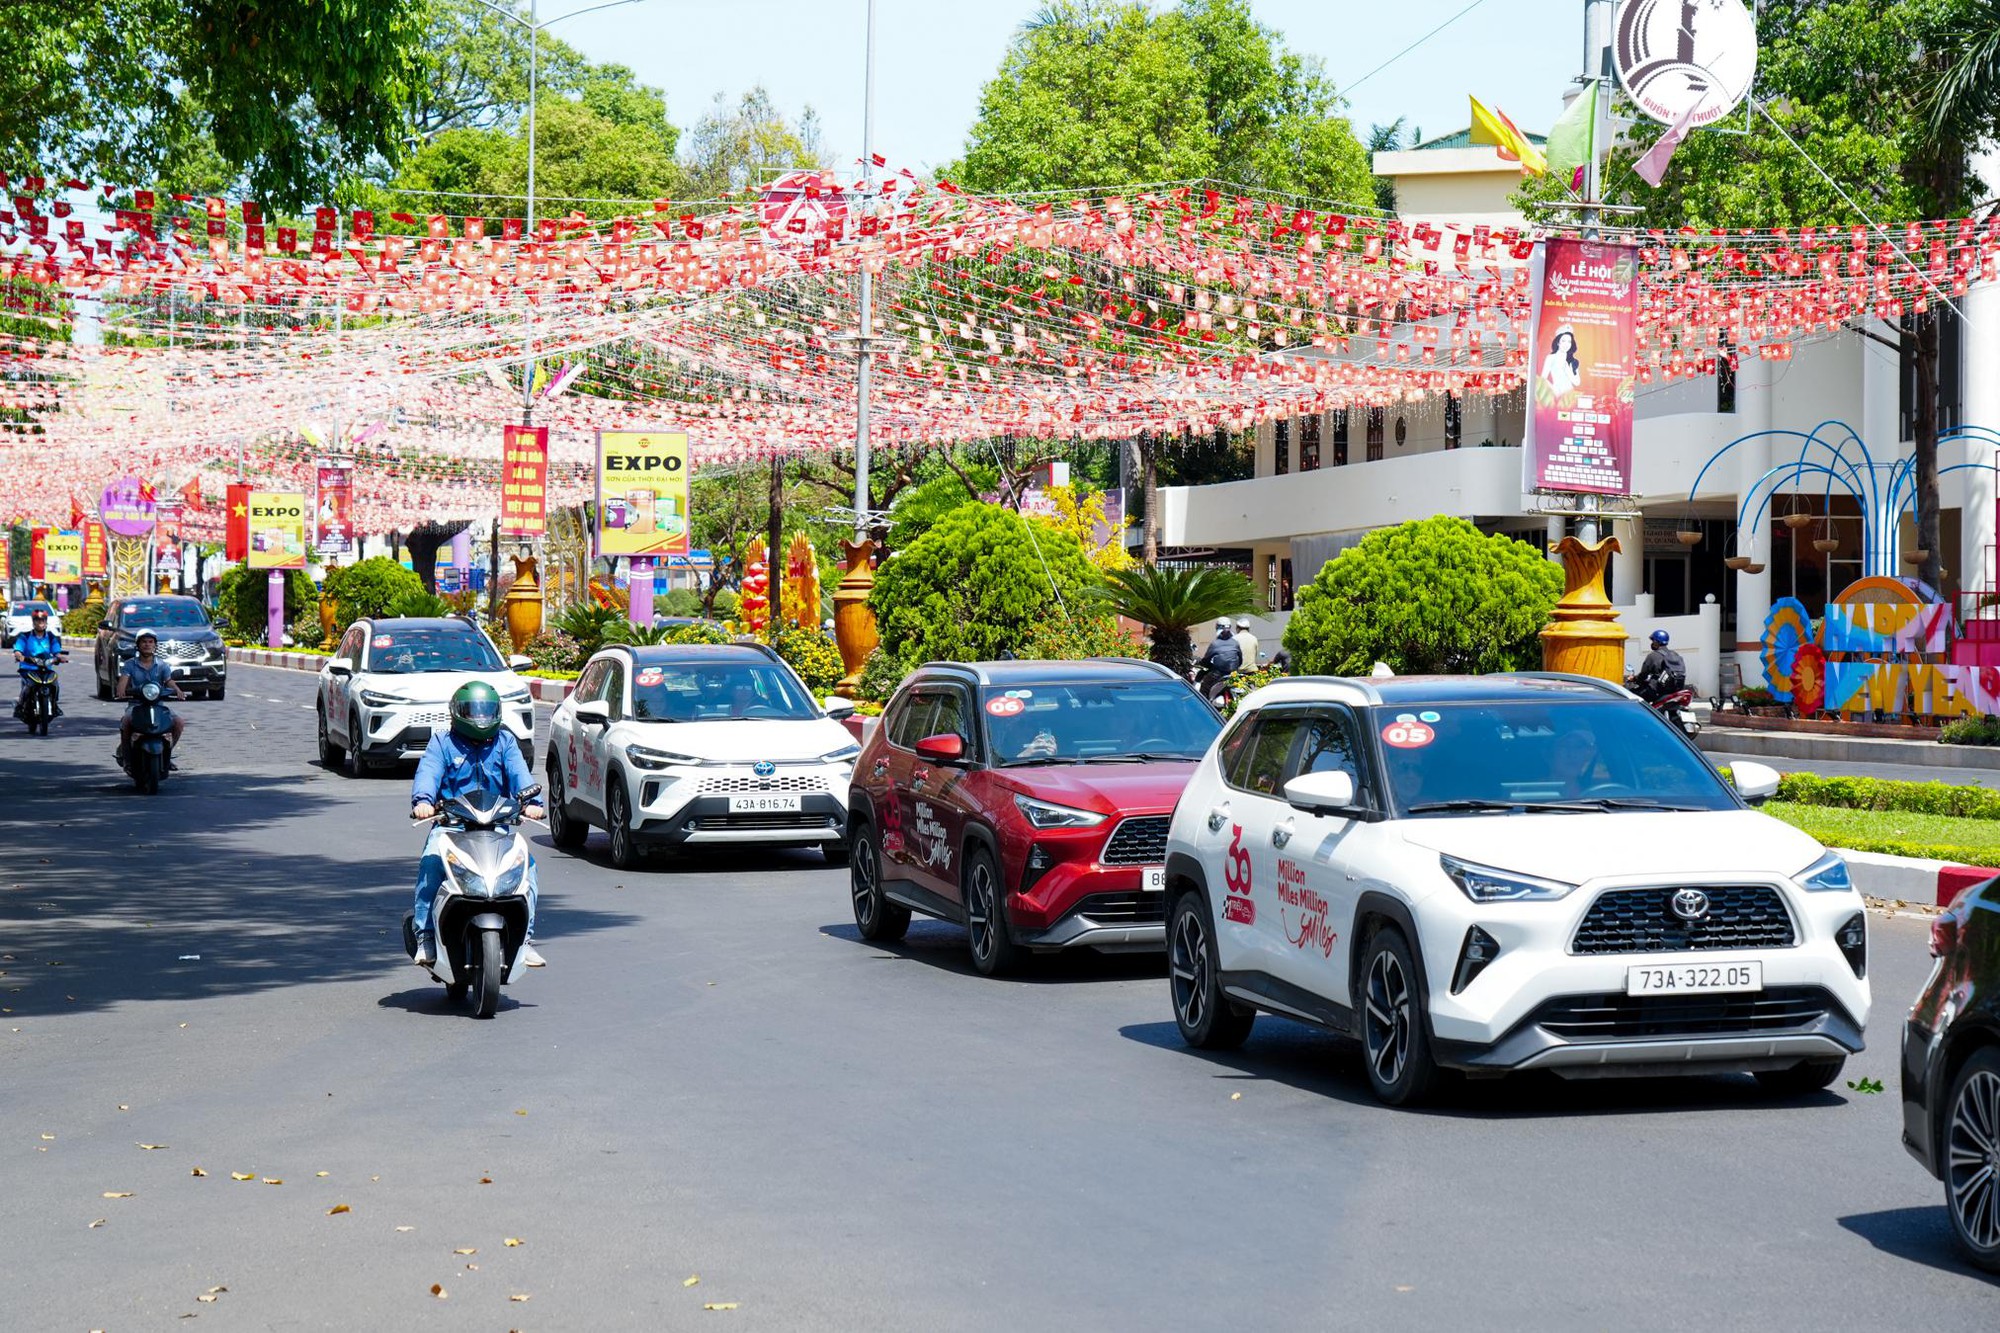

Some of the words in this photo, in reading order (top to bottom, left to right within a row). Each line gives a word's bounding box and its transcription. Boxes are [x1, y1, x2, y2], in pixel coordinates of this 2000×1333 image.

[1570, 261, 1586, 276] LỄ
[1588, 265, 1612, 281] HỘI
[606, 455, 682, 471] EXPO
[252, 507, 300, 517] EXPO
[1824, 603, 1952, 652] HAPPY
[640, 675, 660, 684] 07
[1824, 662, 1903, 712] NEW
[1908, 664, 2000, 716] YEAR
[991, 701, 1019, 713] 06
[1388, 728, 1427, 743] 05
[736, 799, 795, 809] 43A-816.74
[1277, 859, 1306, 886] Million
[1277, 882, 1298, 906] Miles
[1299, 888, 1328, 916] Million
[1640, 967, 1751, 989] 73A-322.05
